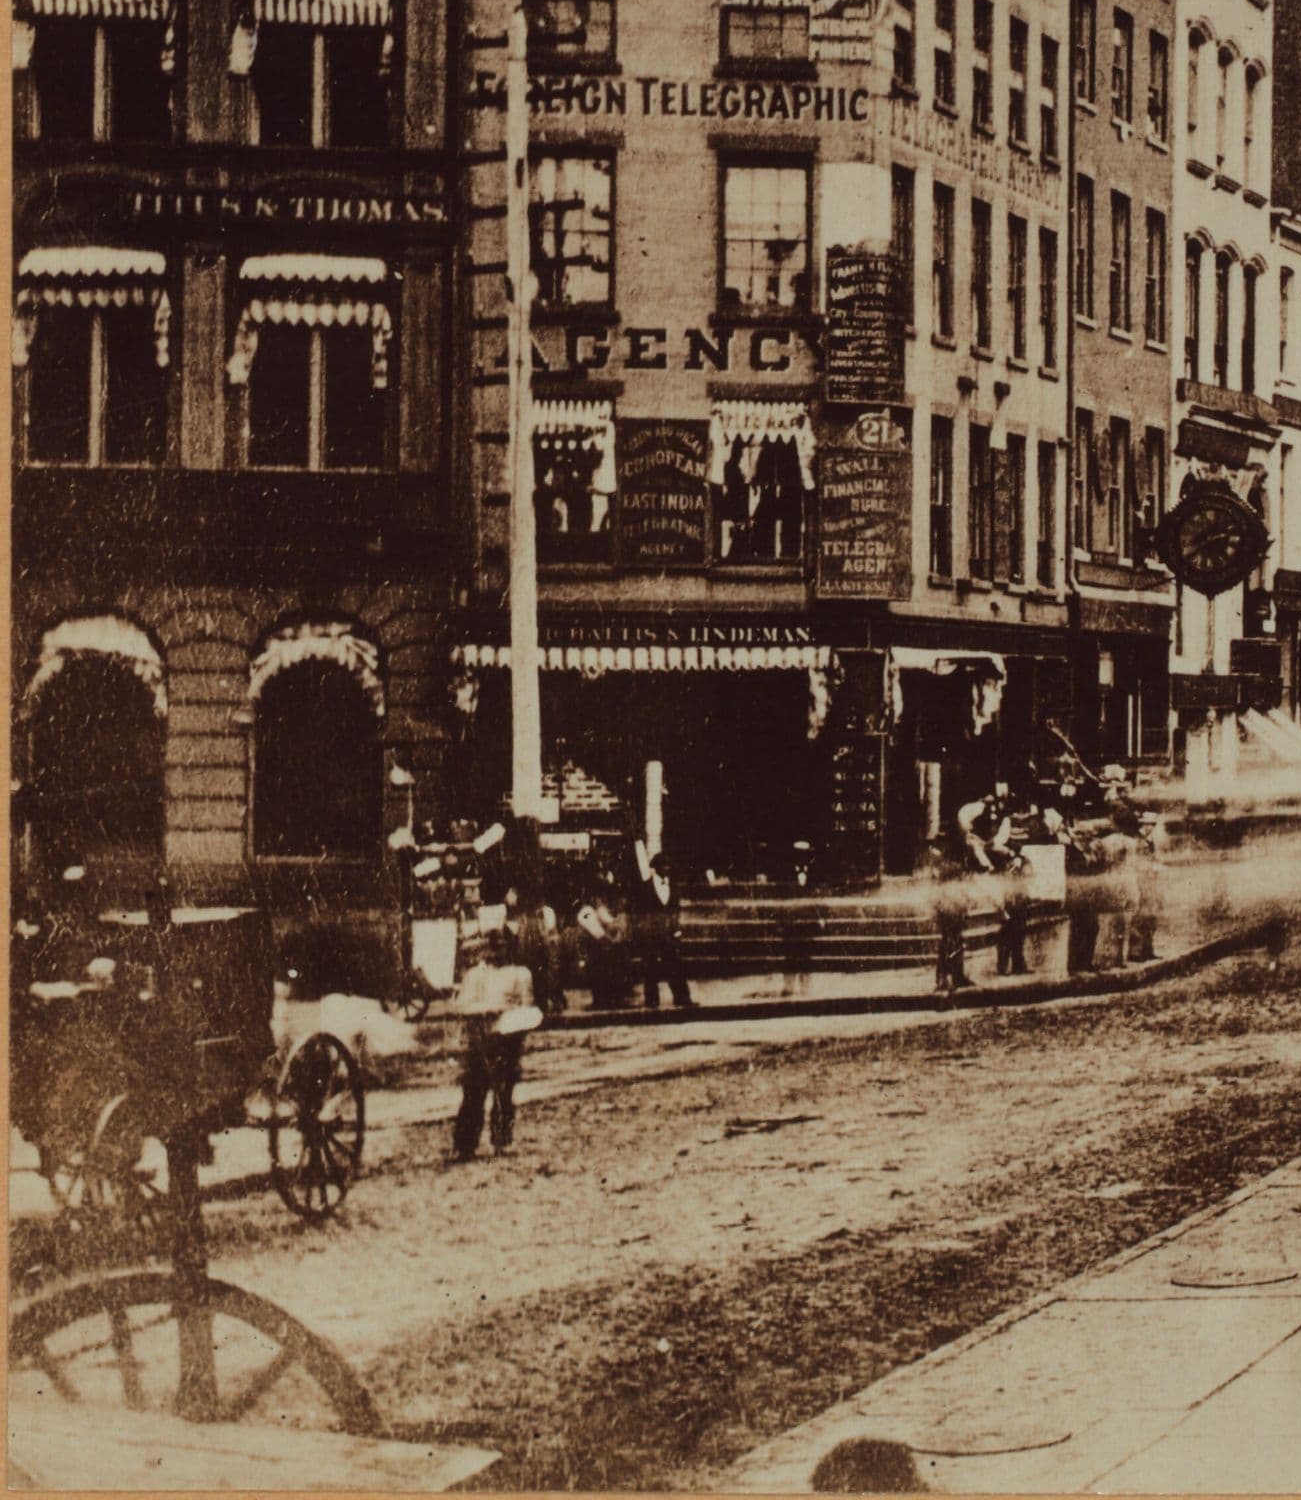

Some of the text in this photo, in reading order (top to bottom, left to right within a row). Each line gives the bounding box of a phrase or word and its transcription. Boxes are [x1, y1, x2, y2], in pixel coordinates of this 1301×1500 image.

[636, 77, 870, 122] TELEGRAPHIC
[487, 328, 825, 374] AGENC
[861, 418, 889, 445] 21
[623, 449, 706, 480] EUROPEAN
[623, 492, 705, 510] EAST INDIA
